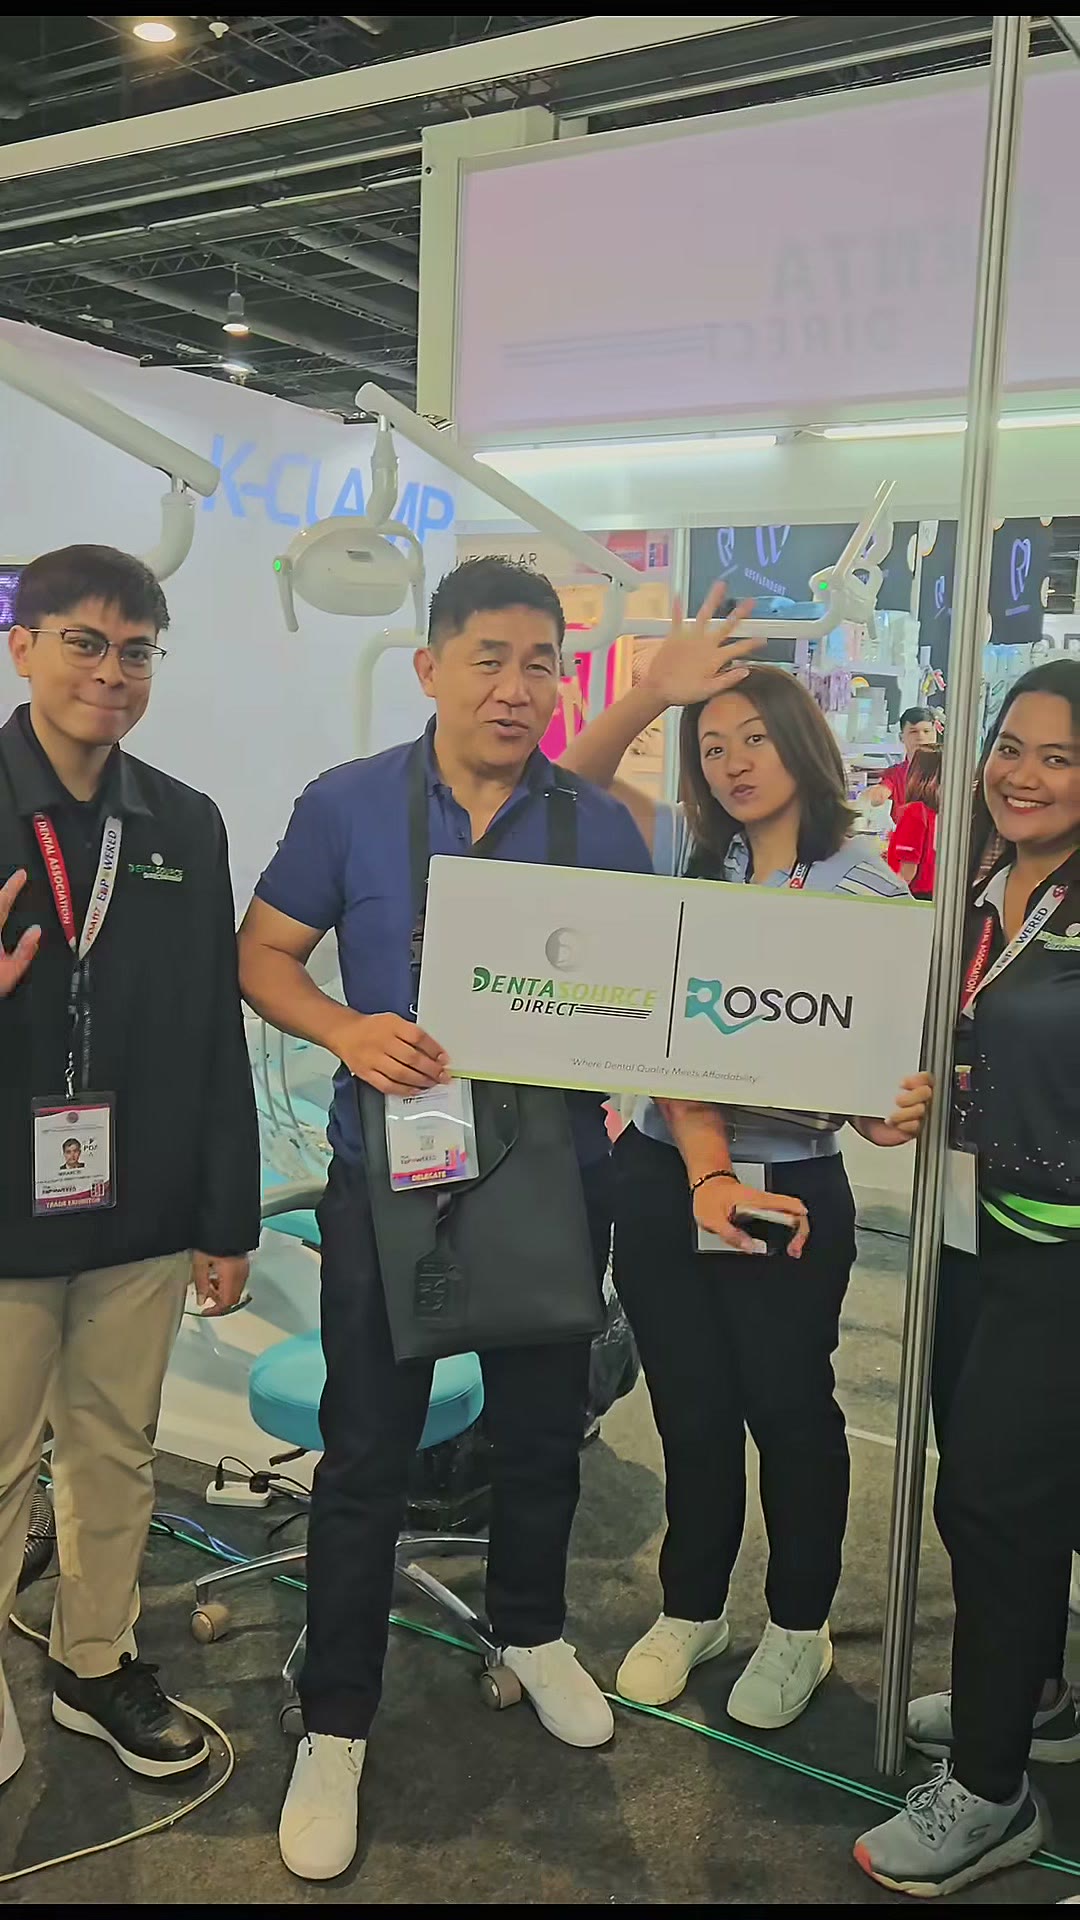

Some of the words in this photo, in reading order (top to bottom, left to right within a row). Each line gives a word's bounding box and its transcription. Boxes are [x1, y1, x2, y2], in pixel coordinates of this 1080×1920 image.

[37, 820, 56, 859] DENTAL
[47, 855, 71, 925] ASSOCIATION
[511, 998, 578, 1017] DIRECT
[685, 977, 853, 1034] ROSON
[604, 1060, 635, 1071] Dental
[637, 1063, 669, 1076] Quality
[672, 1067, 699, 1077] Meets
[411, 1170, 447, 1182] DELEGATE
